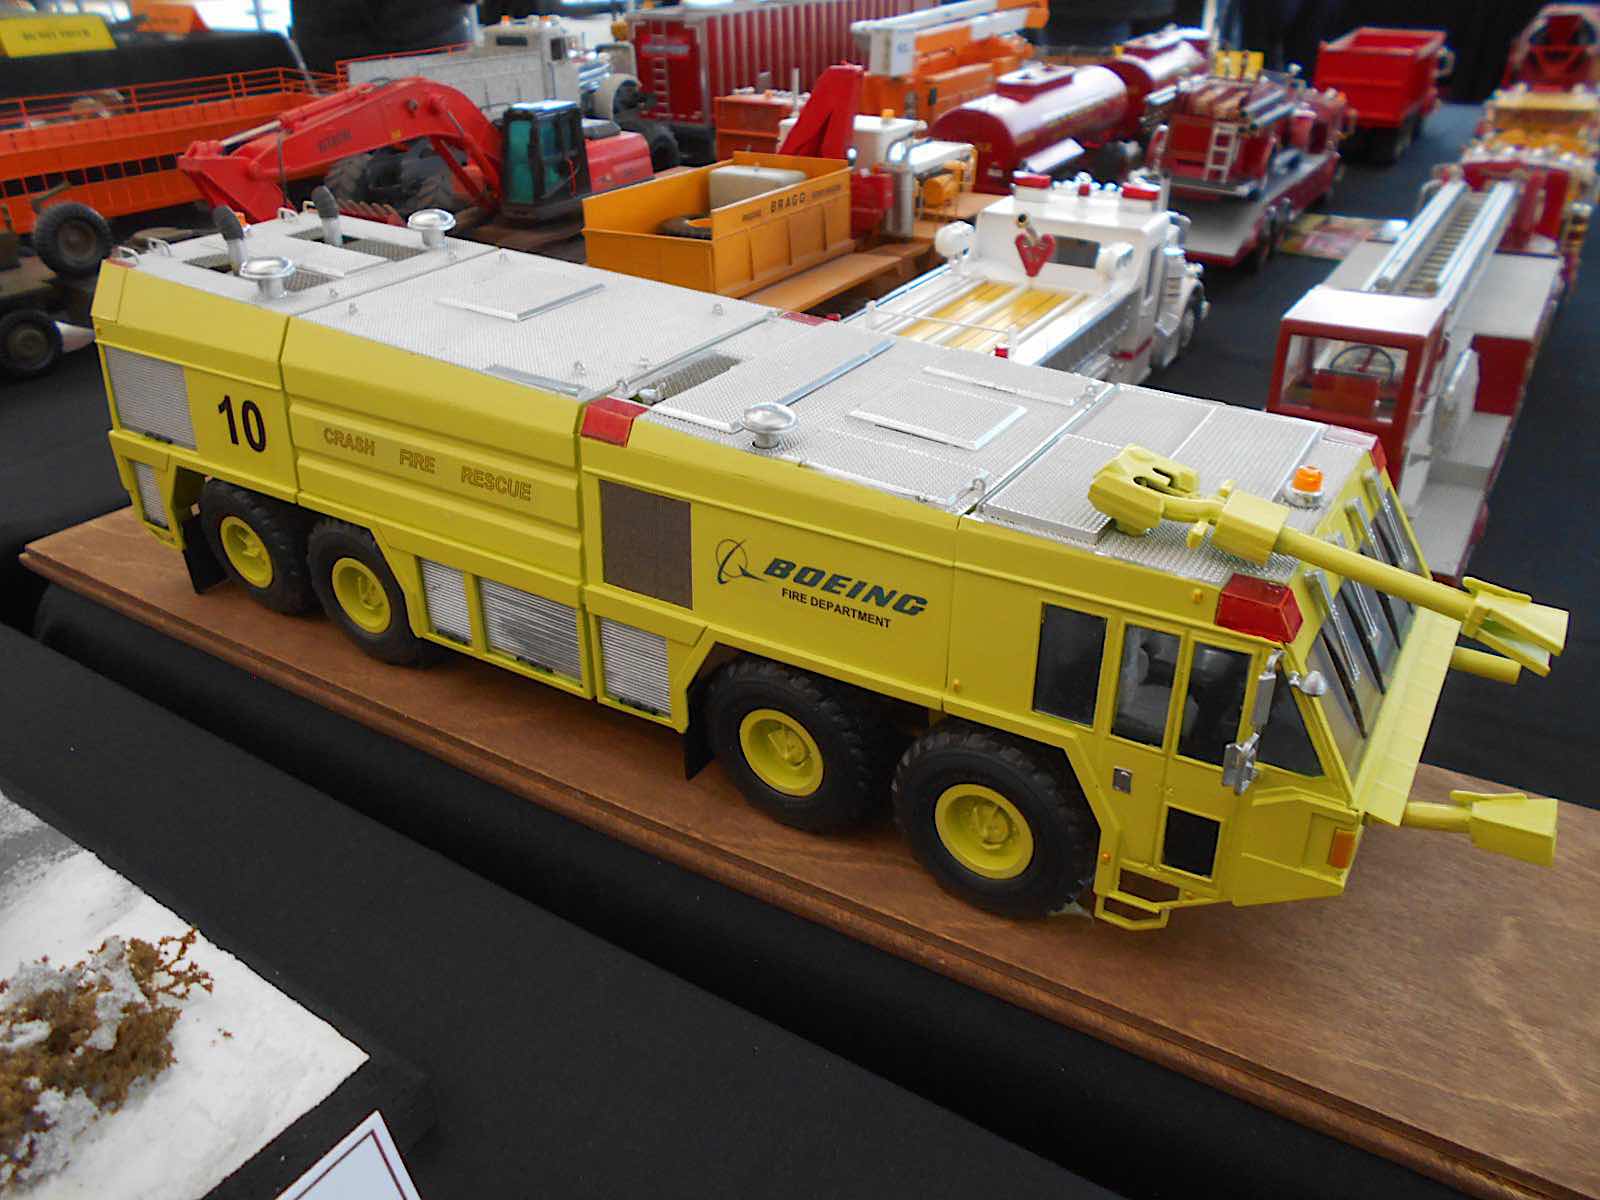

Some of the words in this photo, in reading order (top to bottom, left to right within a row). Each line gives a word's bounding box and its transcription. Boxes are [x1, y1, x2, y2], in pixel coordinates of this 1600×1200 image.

[770, 192, 806, 213] BRAGG
[218, 395, 266, 452] 10
[323, 427, 376, 457] CRASH
[399, 448, 436, 475] FIRE
[461, 465, 532, 502] RESCUE
[763, 557, 928, 616] BOEING
[781, 587, 808, 605] FIRE
[810, 596, 892, 629] DEPARTMENT
